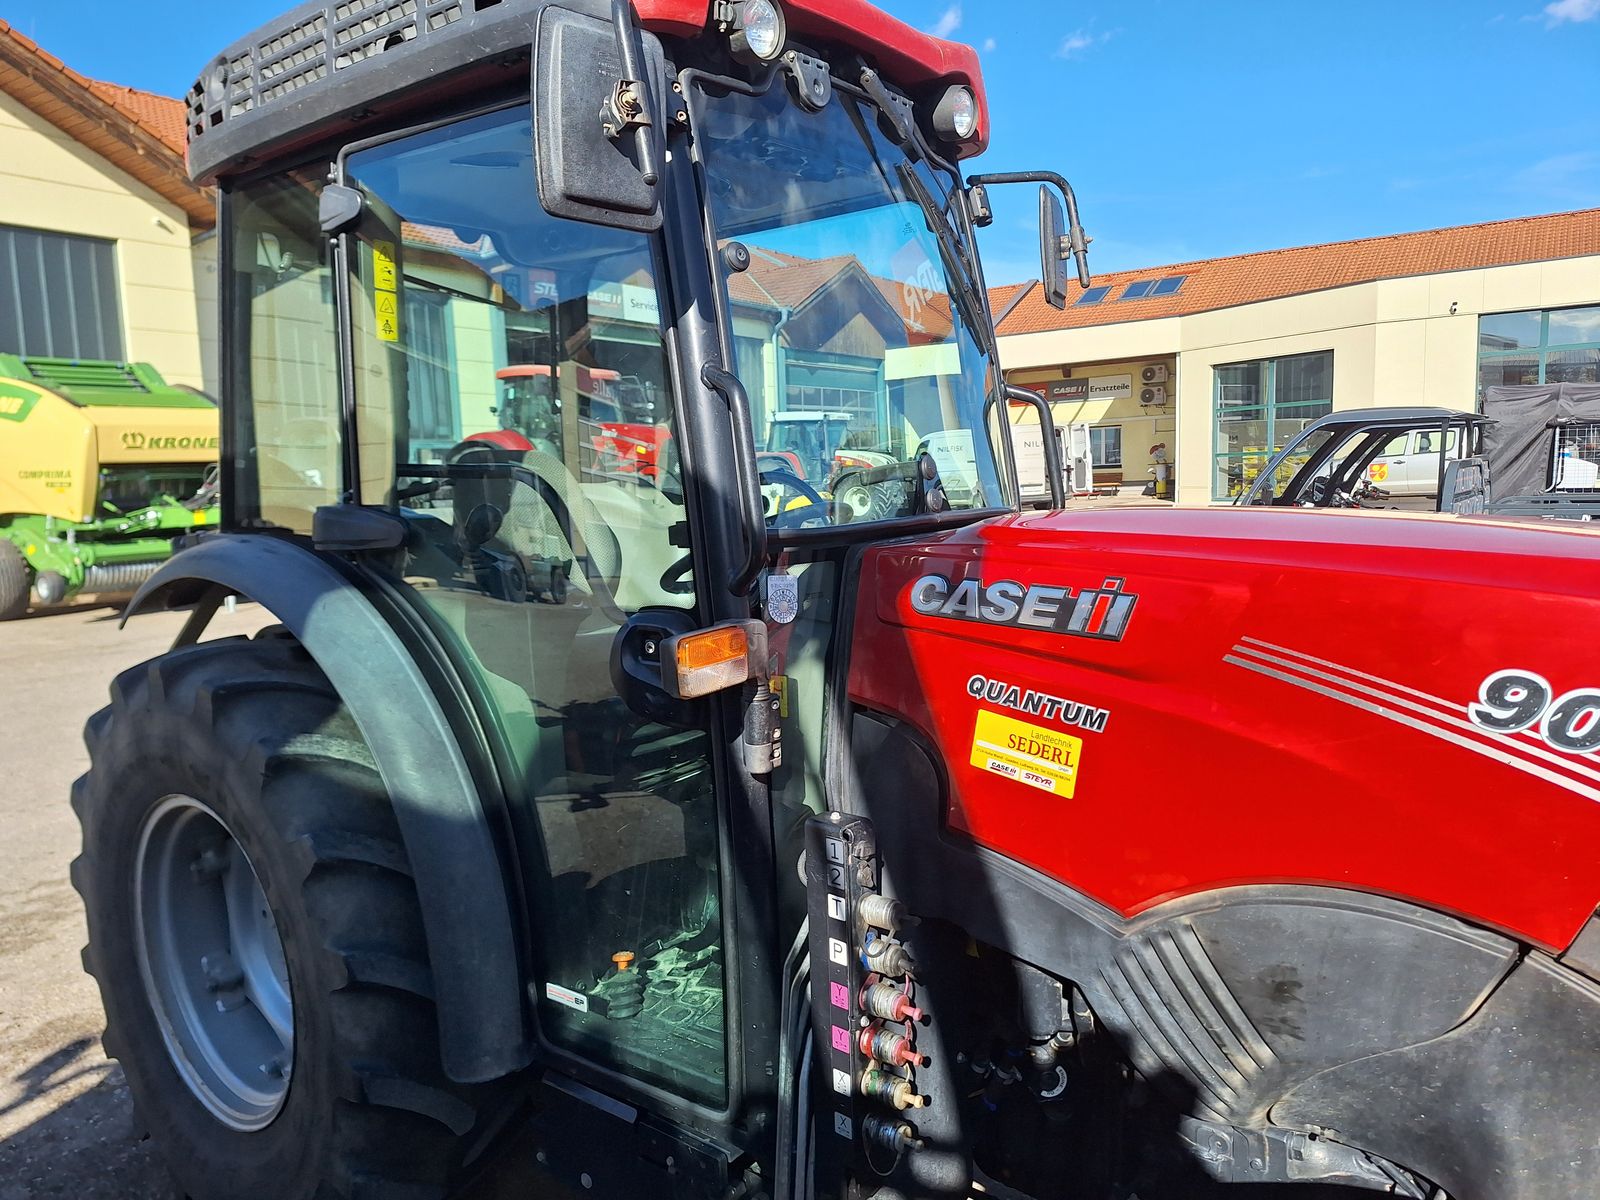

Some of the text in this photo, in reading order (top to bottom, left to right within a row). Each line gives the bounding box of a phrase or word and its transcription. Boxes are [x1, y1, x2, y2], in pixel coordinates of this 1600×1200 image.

[1089, 383, 1131, 393] Ersatzteile
[148, 436, 219, 449] KRONE
[937, 445, 963, 453] NILFISK
[910, 573, 1066, 629] CASE
[967, 674, 1111, 733] QUANTUM
[1031, 730, 1072, 748] Landtechnik
[1008, 734, 1074, 767] SEDERL
[991, 762, 1009, 771] CASE
[1024, 773, 1052, 786] STEYR
[830, 842, 839, 860] 1
[831, 867, 841, 886] 2
[832, 897, 842, 916] T
[833, 942, 843, 959] P
[836, 985, 843, 996] Y
[837, 1031, 844, 1042] Y
[838, 1071, 846, 1084] X
[839, 1115, 847, 1128] X
